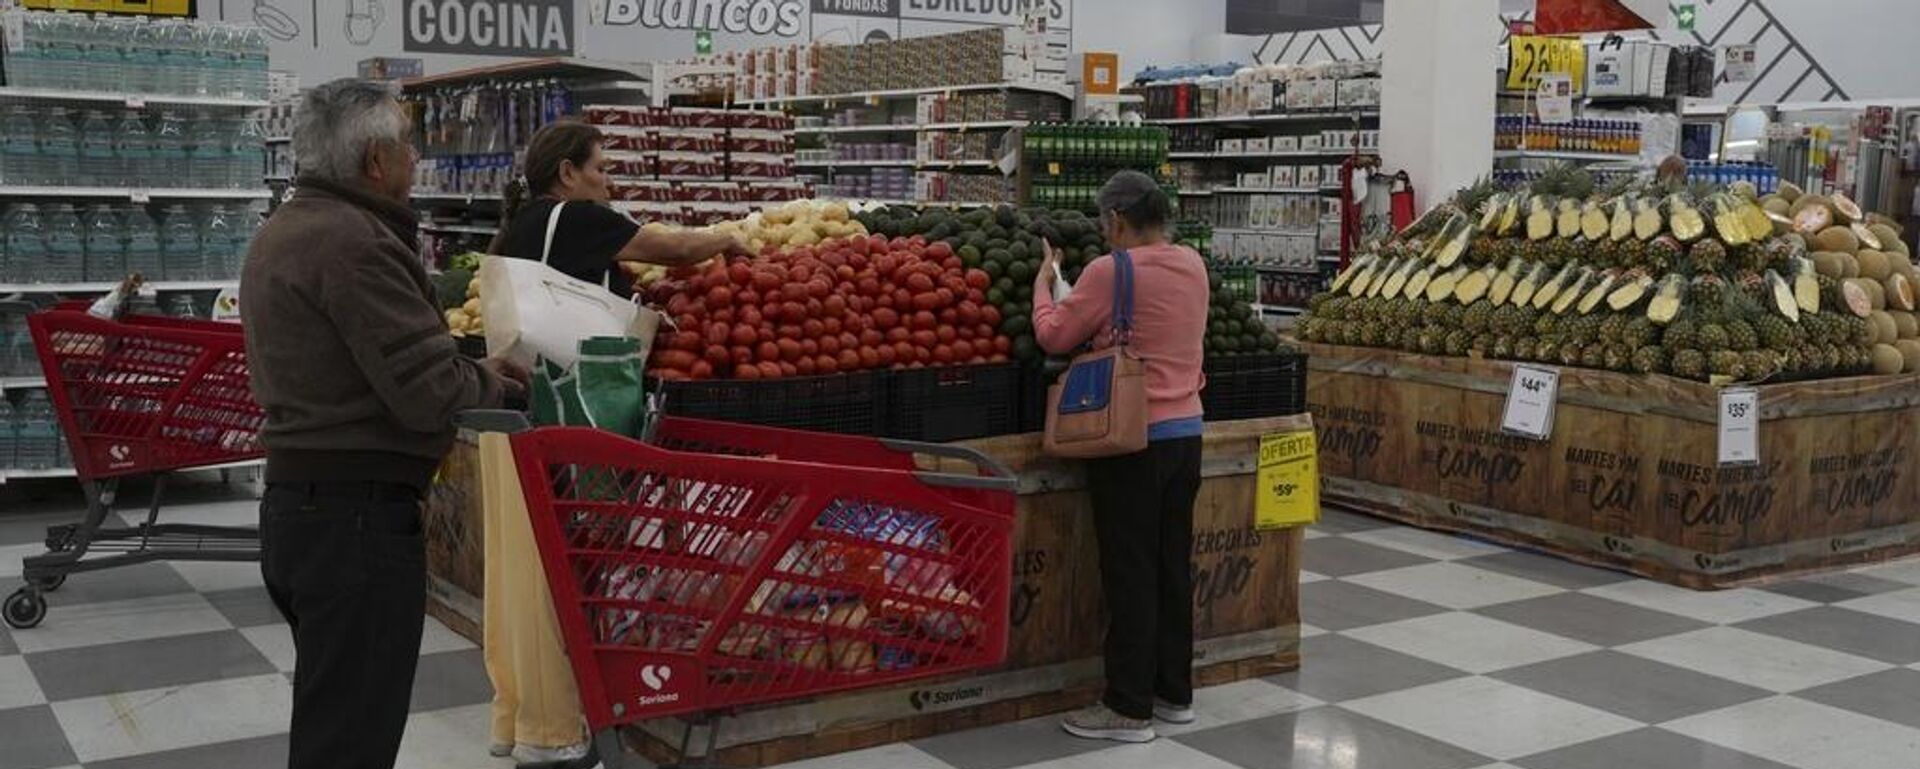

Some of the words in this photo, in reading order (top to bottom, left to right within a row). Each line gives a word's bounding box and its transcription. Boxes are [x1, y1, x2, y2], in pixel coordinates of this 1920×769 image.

[409, 0, 568, 50] COCINA
[1261, 436, 1314, 461] OFERTA
[1565, 446, 1617, 470] MARTES
[1657, 459, 1713, 485] MARTES
